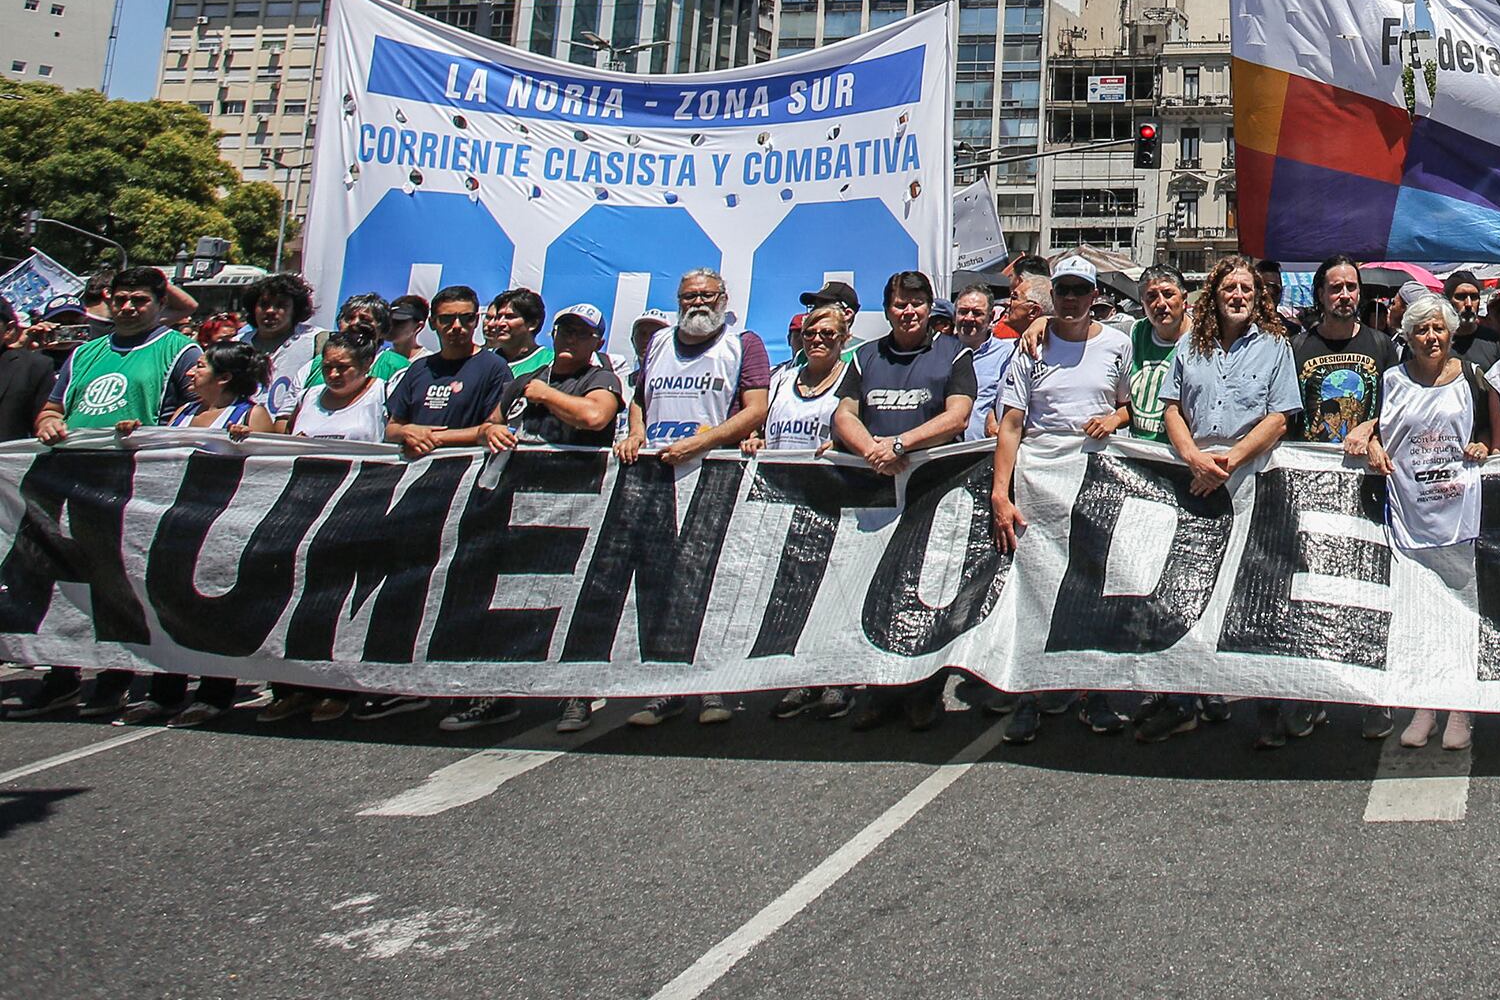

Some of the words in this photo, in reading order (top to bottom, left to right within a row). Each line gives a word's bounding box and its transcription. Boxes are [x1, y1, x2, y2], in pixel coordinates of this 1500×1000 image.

[445, 63, 489, 103] LA
[506, 69, 625, 120] NORIA
[673, 86, 769, 120] ZONA
[787, 72, 856, 115] SUR
[359, 124, 531, 179] CORRIENTE
[544, 145, 697, 187] CLASISTA
[711, 153, 732, 187] Y
[743, 133, 921, 186] COMBATIVA
[1319, 354, 1371, 365] DESIGUALDAD
[89, 376, 124, 403] ATE
[427, 384, 452, 397] CCC
[866, 389, 921, 406] CTA
[78, 399, 128, 415] CIVILES
[770, 418, 819, 437] ONADUH
[1414, 469, 1451, 482] CTA
[0, 449, 1013, 664] AUMENTO
[1044, 452, 1390, 670] DE
